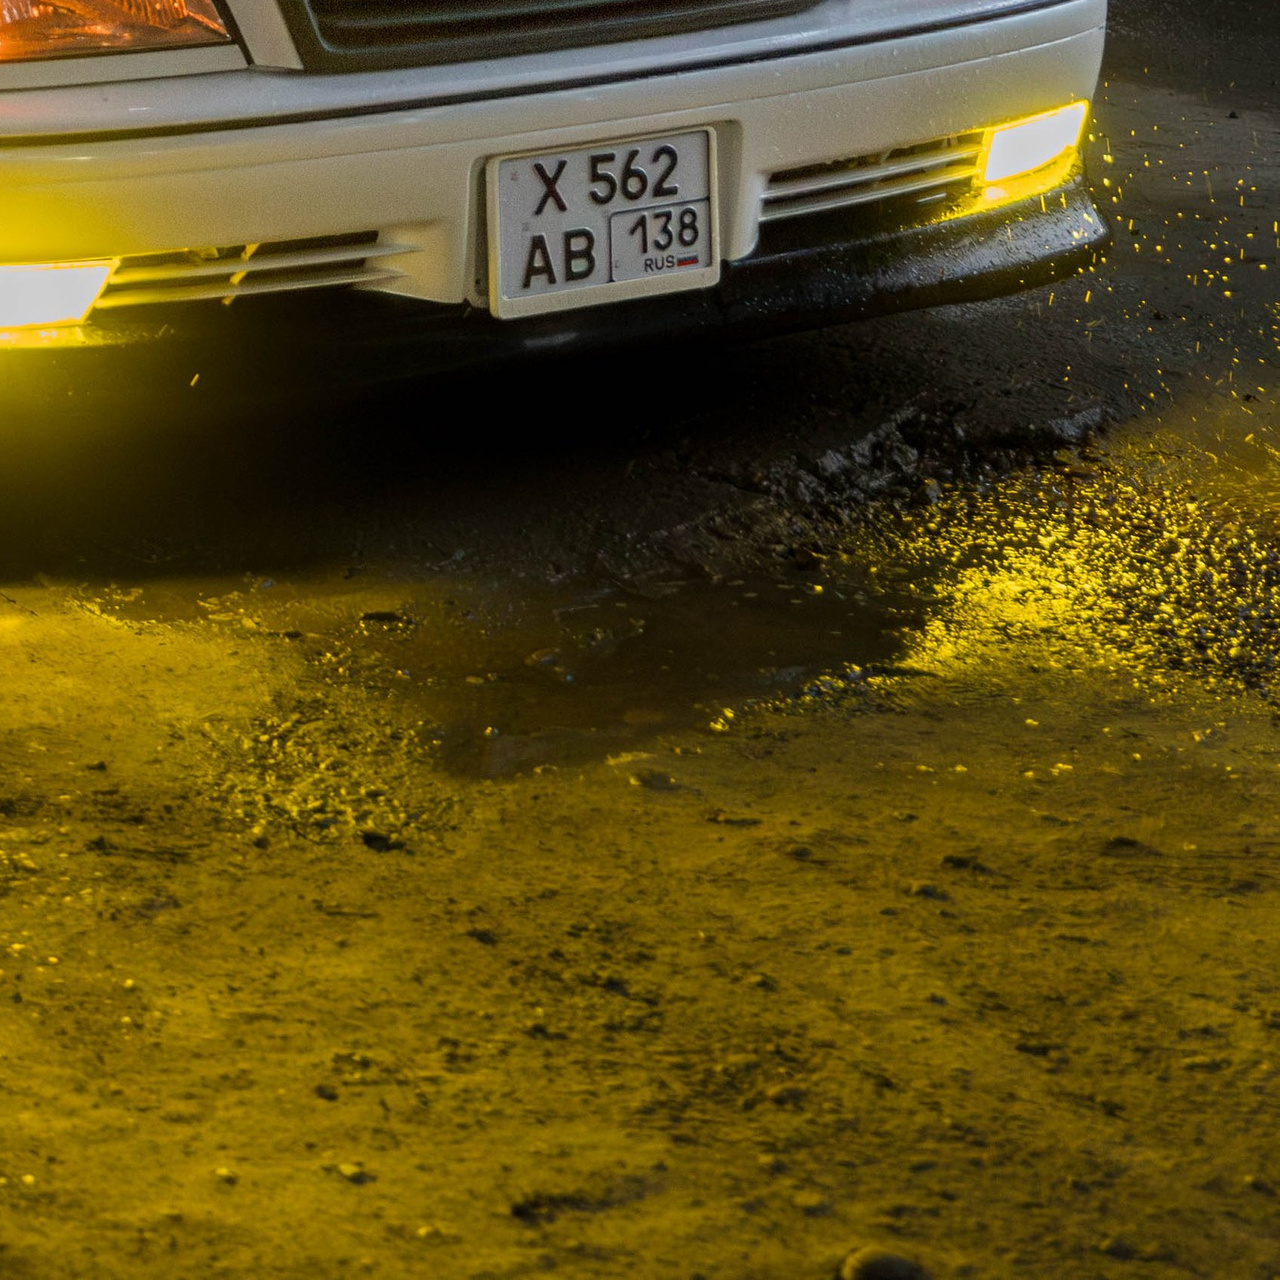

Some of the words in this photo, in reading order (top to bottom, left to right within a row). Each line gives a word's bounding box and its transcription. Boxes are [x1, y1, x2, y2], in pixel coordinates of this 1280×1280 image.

[533, 159, 568, 216] X
[588, 143, 680, 205] 562
[522, 226, 596, 289] AB
[629, 206, 700, 254] 138
[643, 254, 676, 272] RUS
